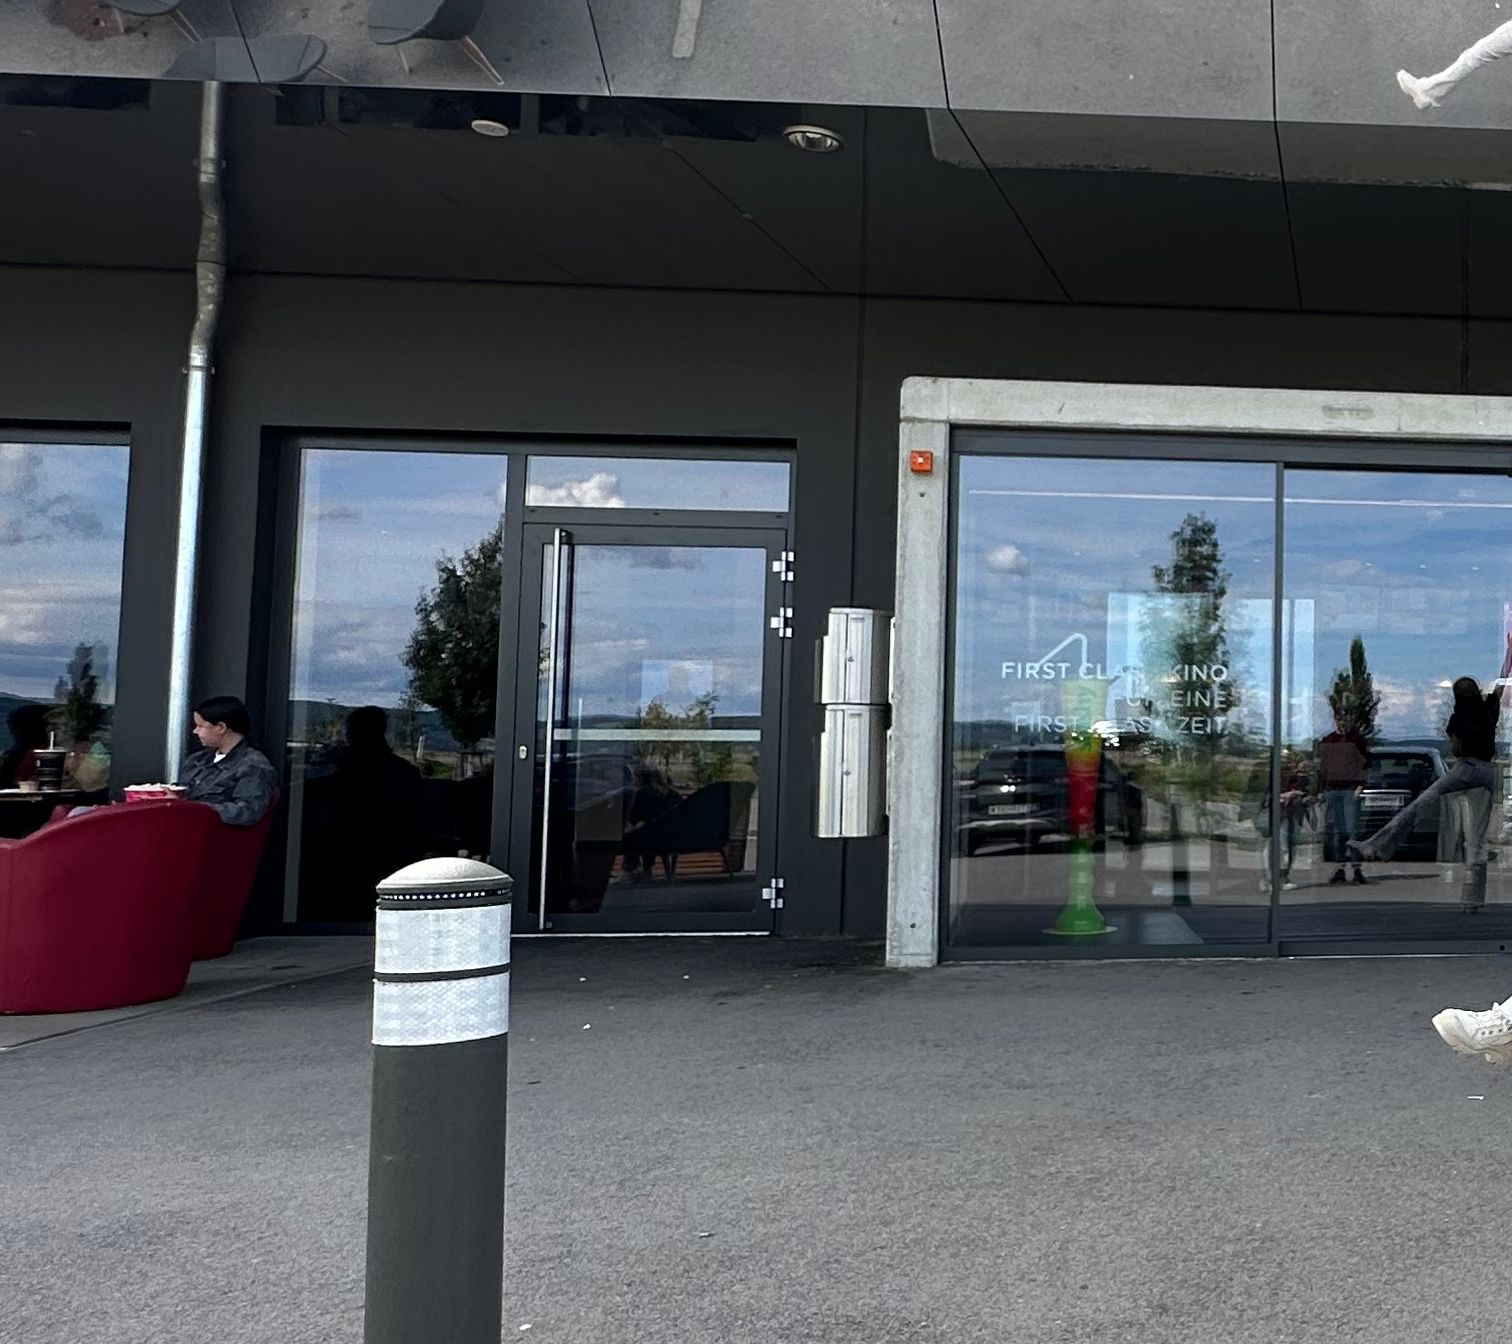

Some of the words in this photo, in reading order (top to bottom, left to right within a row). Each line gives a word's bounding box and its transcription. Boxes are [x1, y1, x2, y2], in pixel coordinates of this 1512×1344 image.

[1001, 661, 1071, 680] FIRST
[1168, 664, 1228, 682] KINO
[1013, 715, 1079, 734] FIRST
